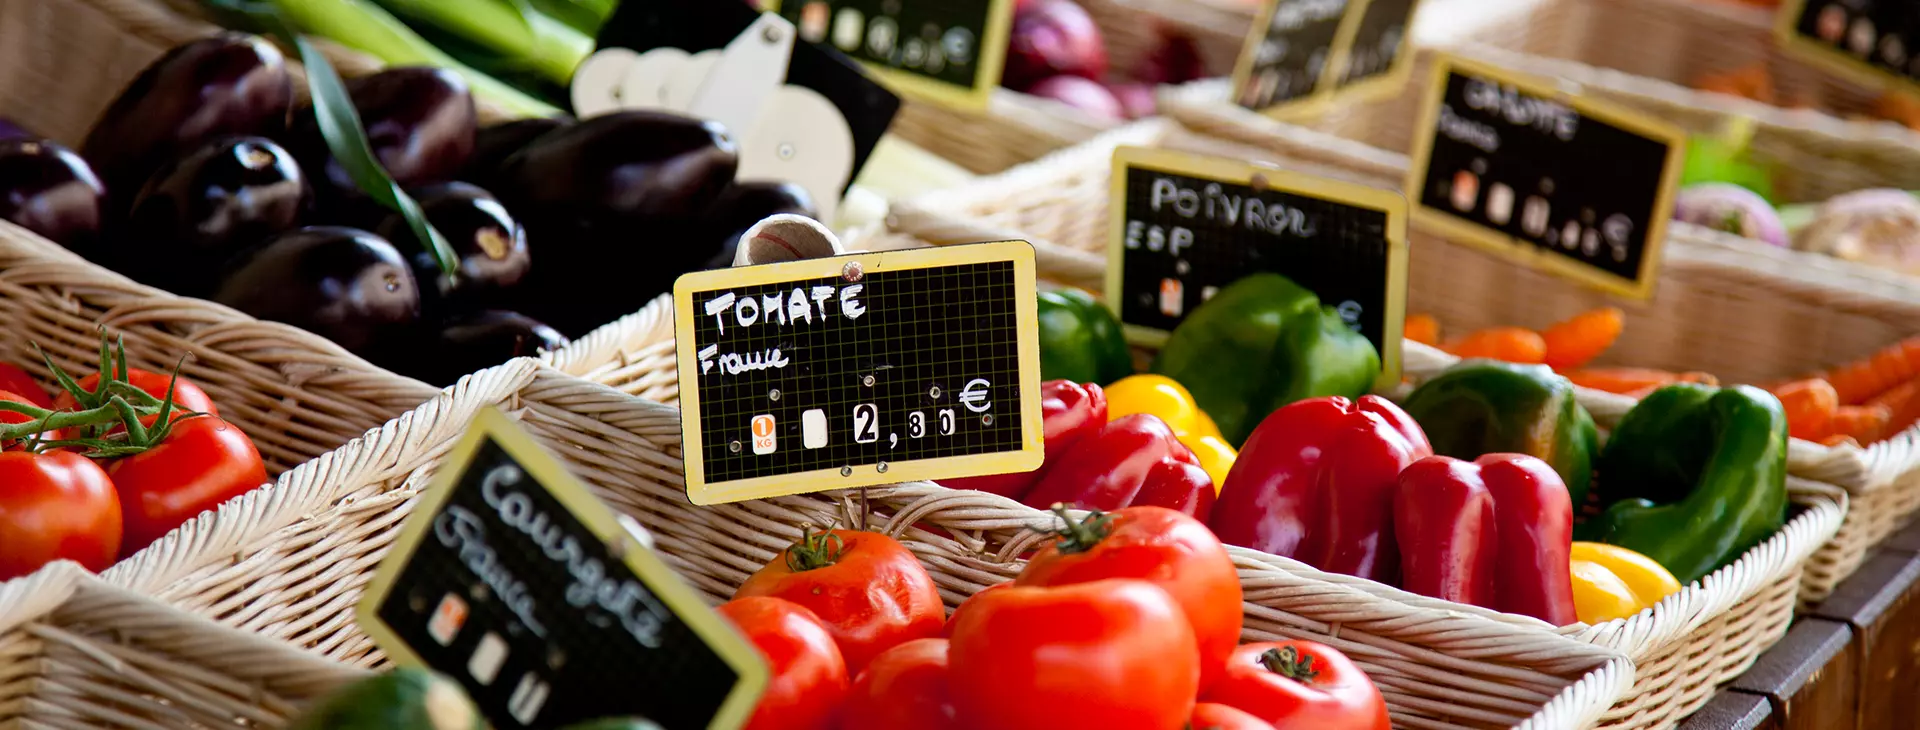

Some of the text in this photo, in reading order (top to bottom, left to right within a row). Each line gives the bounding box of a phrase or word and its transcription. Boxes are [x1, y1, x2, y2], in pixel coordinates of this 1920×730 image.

[1125, 219, 1194, 256] ESP
[704, 284, 866, 336] TOMATE
[698, 343, 789, 376] France
[959, 378, 991, 413] €
[757, 438, 773, 449] KG
